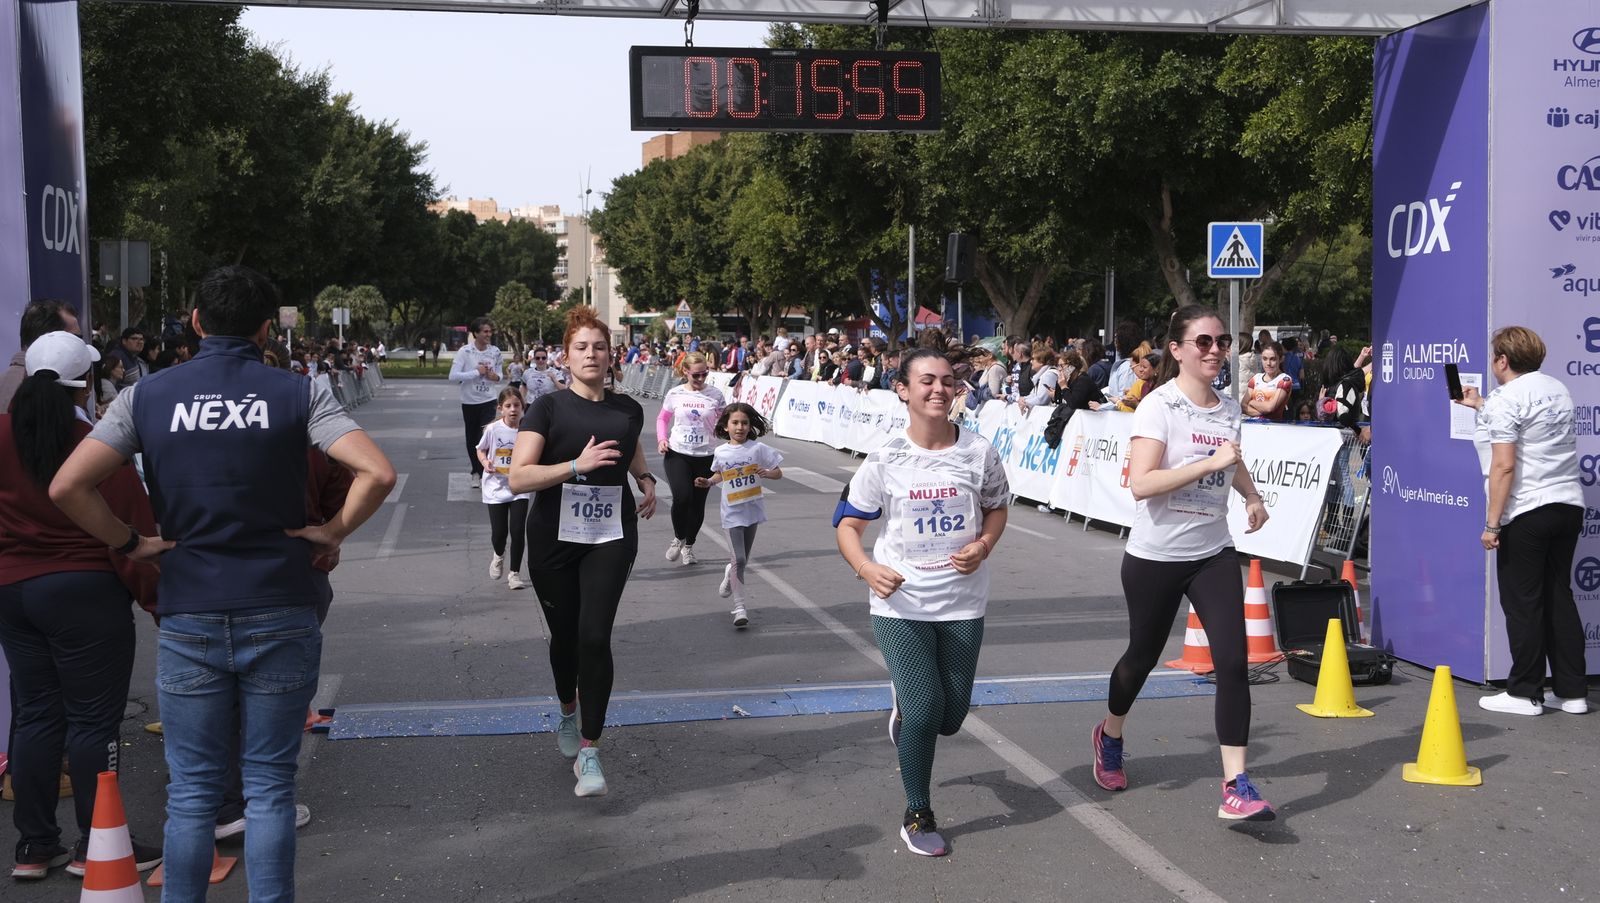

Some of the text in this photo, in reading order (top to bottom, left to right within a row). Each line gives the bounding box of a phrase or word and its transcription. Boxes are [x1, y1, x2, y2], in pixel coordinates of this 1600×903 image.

[684, 56, 925, 121] 00:15:55
[42, 184, 79, 254] CDX
[1388, 182, 1461, 258] CDX
[1404, 339, 1469, 363] ALMERÍA
[1404, 368, 1434, 380] CIUDAD
[684, 434, 704, 443] 1011
[729, 475, 755, 488] 1878
[1249, 457, 1321, 490] ALMERÍA
[910, 487, 958, 500] MUJER
[1241, 490, 1278, 507] DAD
[571, 502, 613, 518] 1056
[914, 514, 965, 534] 1162
